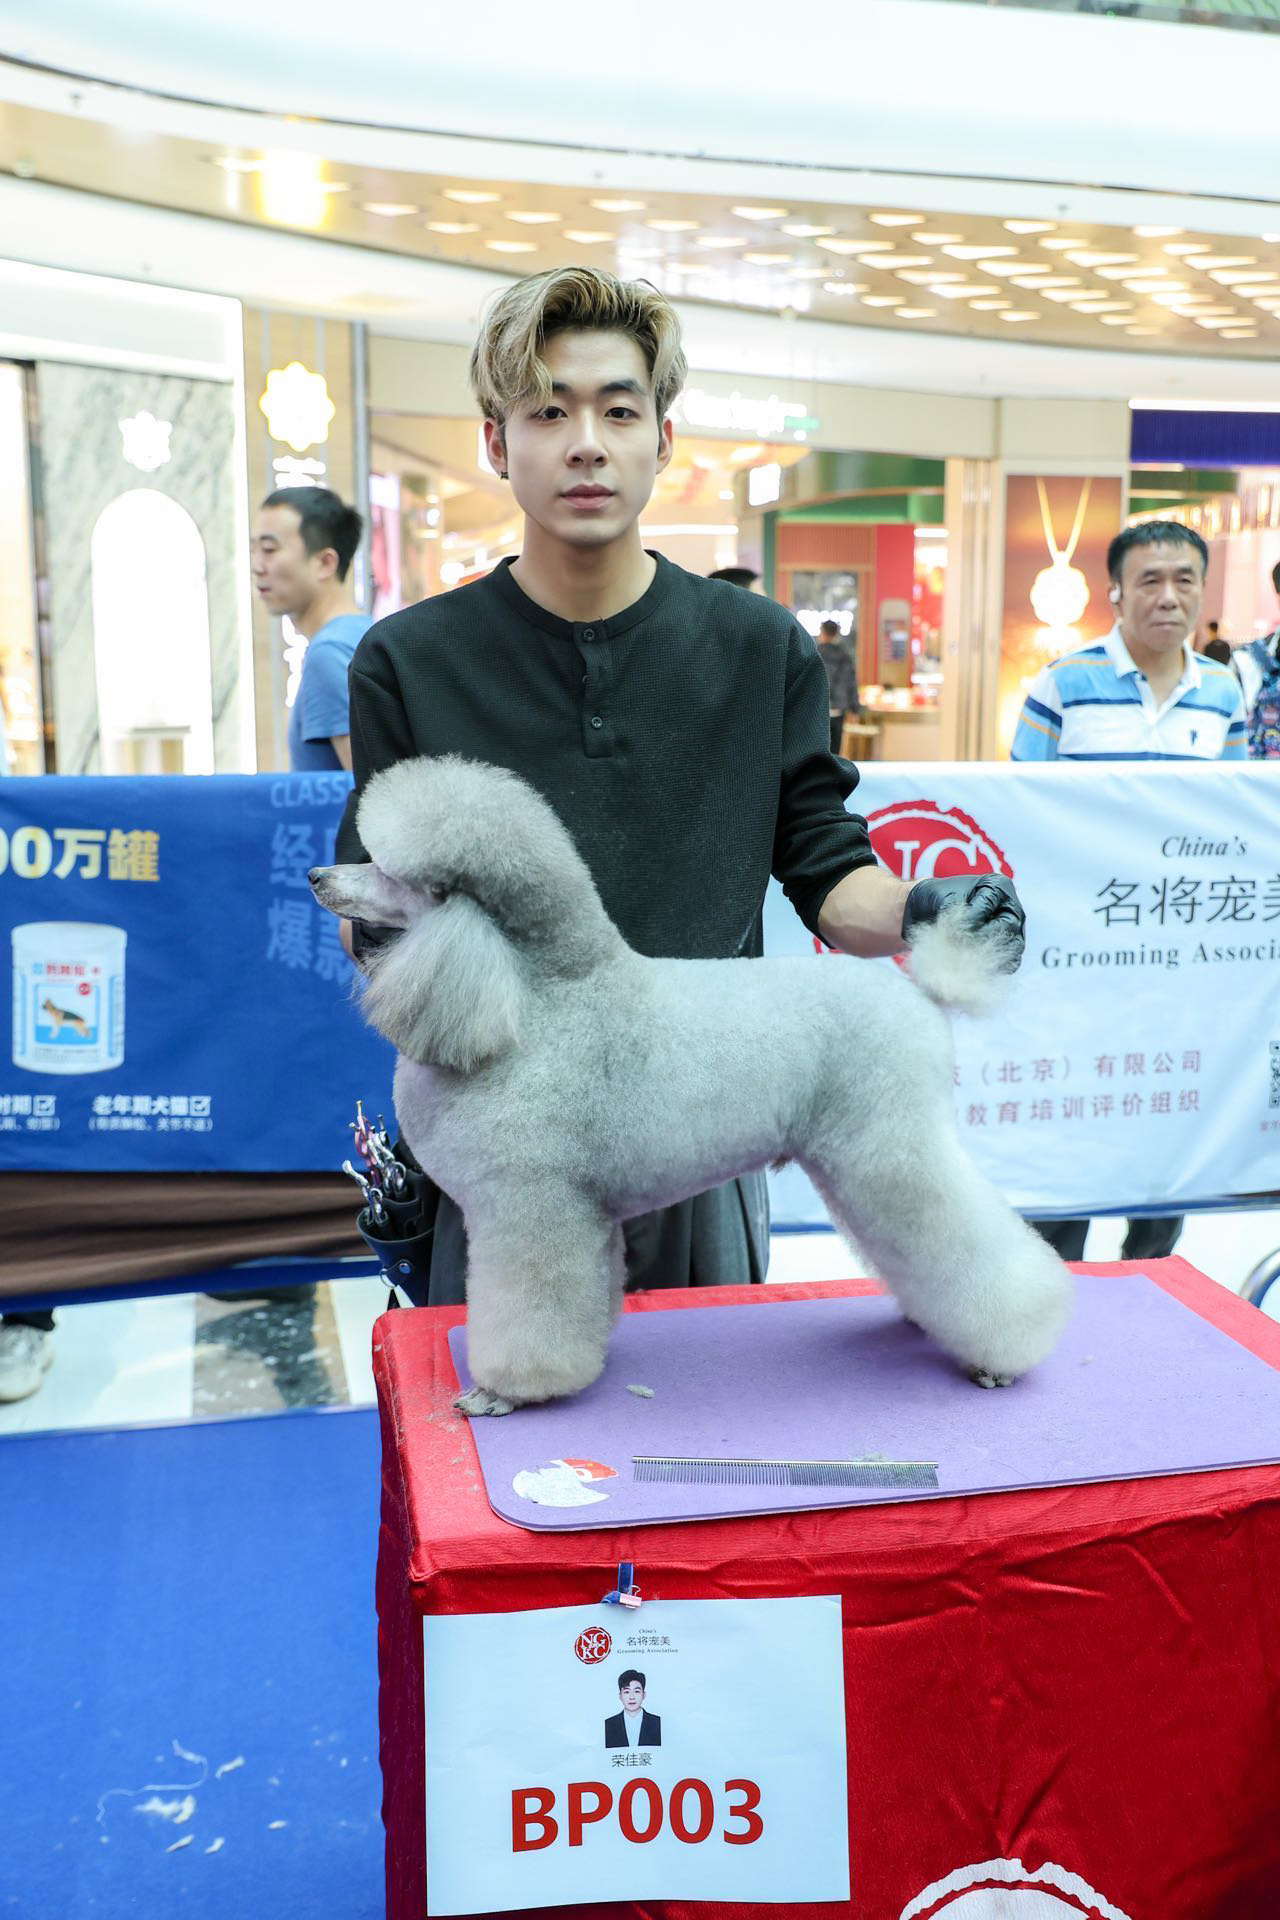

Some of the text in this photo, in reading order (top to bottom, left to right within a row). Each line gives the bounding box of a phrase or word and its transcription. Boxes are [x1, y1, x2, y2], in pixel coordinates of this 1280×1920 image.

[0, 825, 160, 882] 0万罐
[269, 822, 336, 889] 经
[1161, 834, 1248, 858] China's
[1041, 938, 1280, 970] Grooming Associ
[954, 1089, 1200, 1126] 教育培训评价组织
[626, 1636, 671, 1647] 名将宠美
[611, 1752, 653, 1768] 荣佳豪
[511, 1777, 764, 1853] BP003
